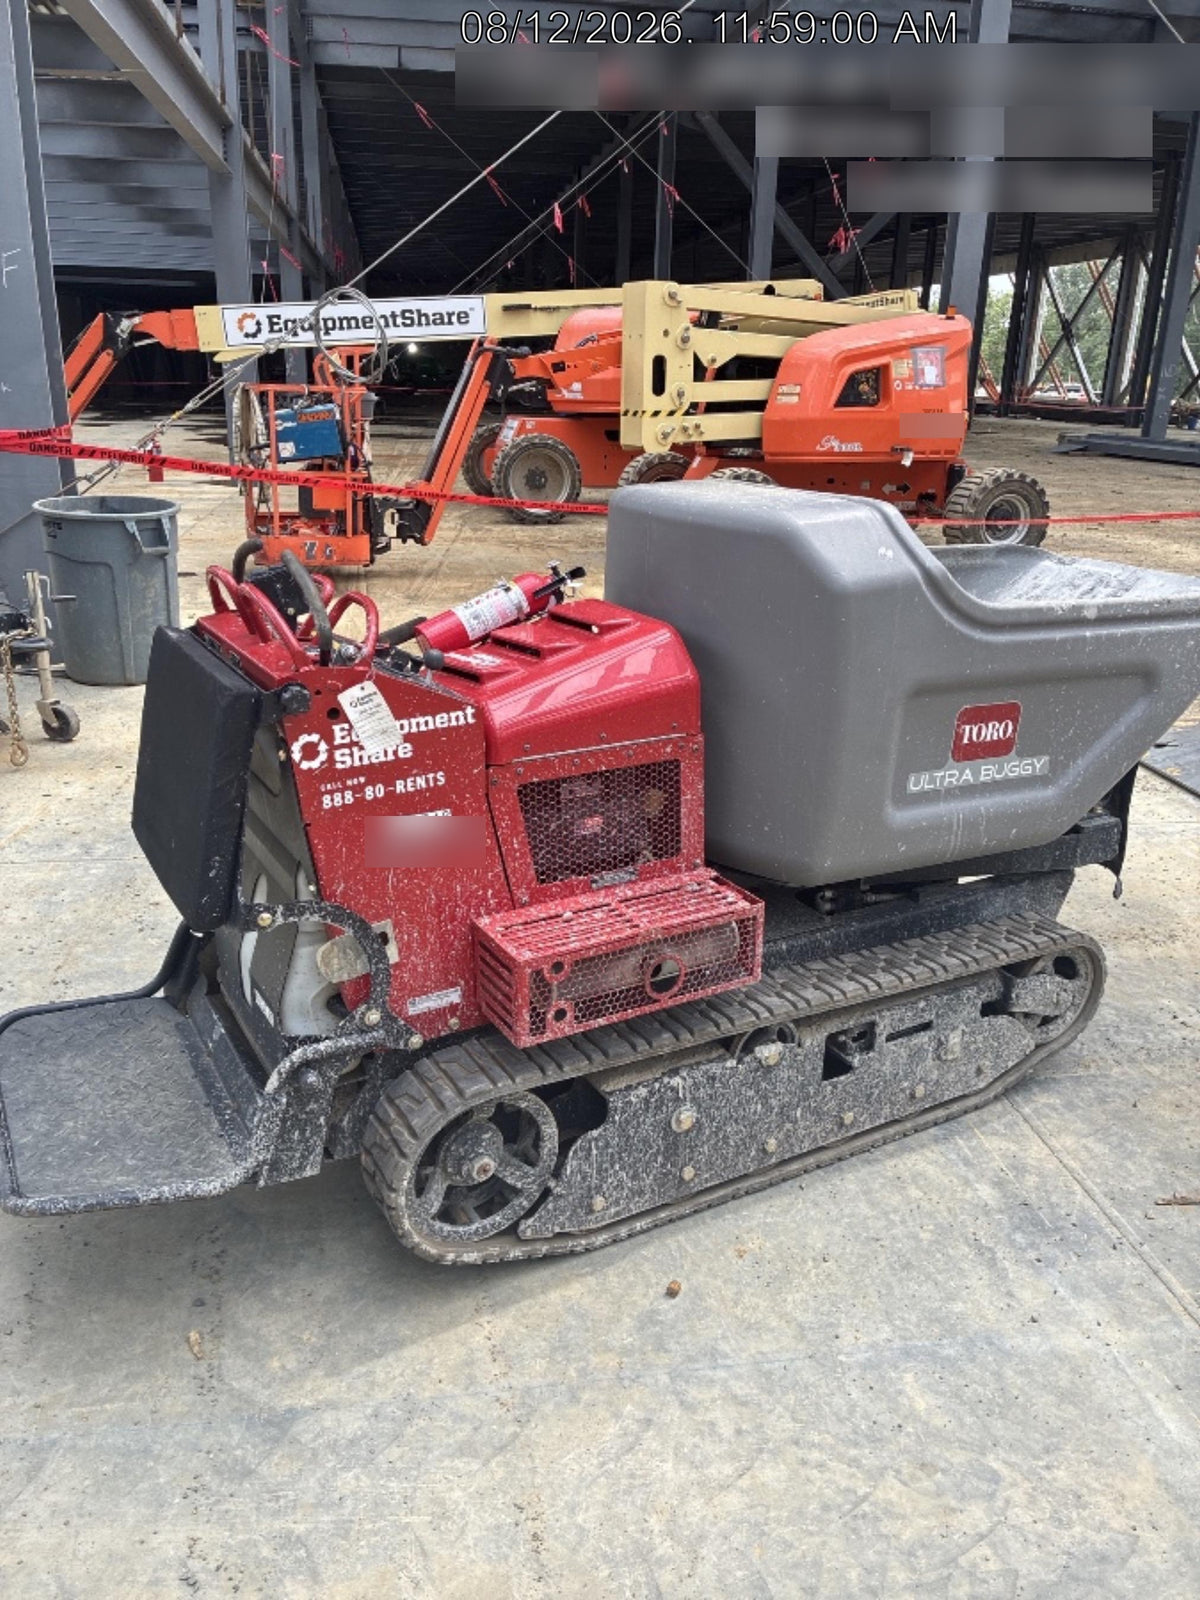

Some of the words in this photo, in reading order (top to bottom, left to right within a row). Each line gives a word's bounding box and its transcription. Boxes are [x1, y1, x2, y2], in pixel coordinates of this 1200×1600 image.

[29, 443, 72, 456] DANGER
[961, 719, 1015, 744] TORO
[334, 742, 413, 769] Share
[346, 776, 366, 787] NOW
[909, 767, 973, 790] ULTRA
[979, 758, 1045, 782] BUGGY
[322, 771, 446, 809] 888-80-RENTS
